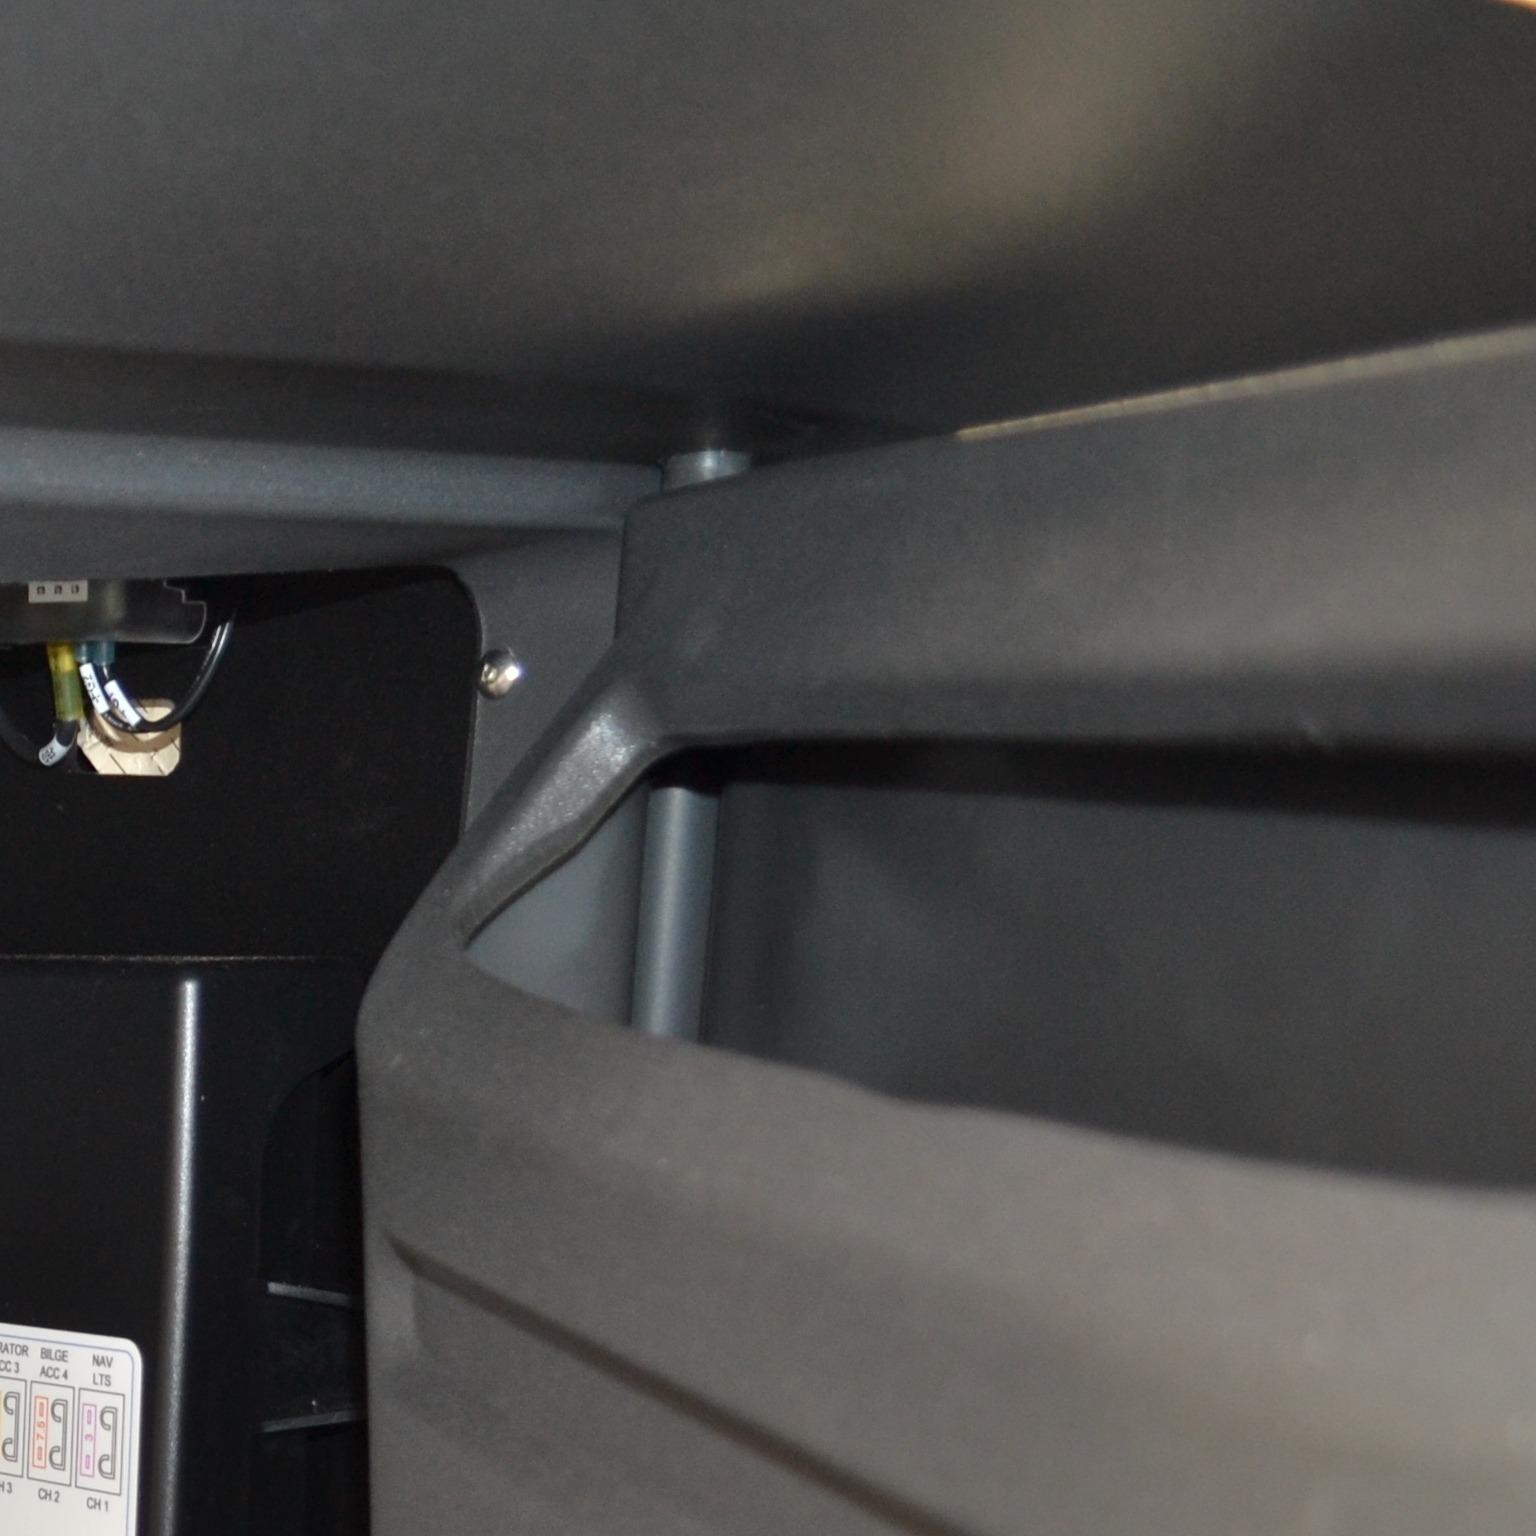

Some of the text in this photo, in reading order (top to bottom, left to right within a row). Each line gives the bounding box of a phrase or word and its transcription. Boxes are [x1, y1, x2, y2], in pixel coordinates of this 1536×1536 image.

[40, 1347, 69, 1363] BILGE
[92, 1354, 114, 1368] NAV
[13, 1362, 20, 1374] 3
[40, 1366, 69, 1381] ACC 4
[92, 1372, 112, 1387] LTS
[5, 1481, 13, 1494] 3
[38, 1488, 60, 1503] CH 2
[86, 1496, 102, 1510] CH
